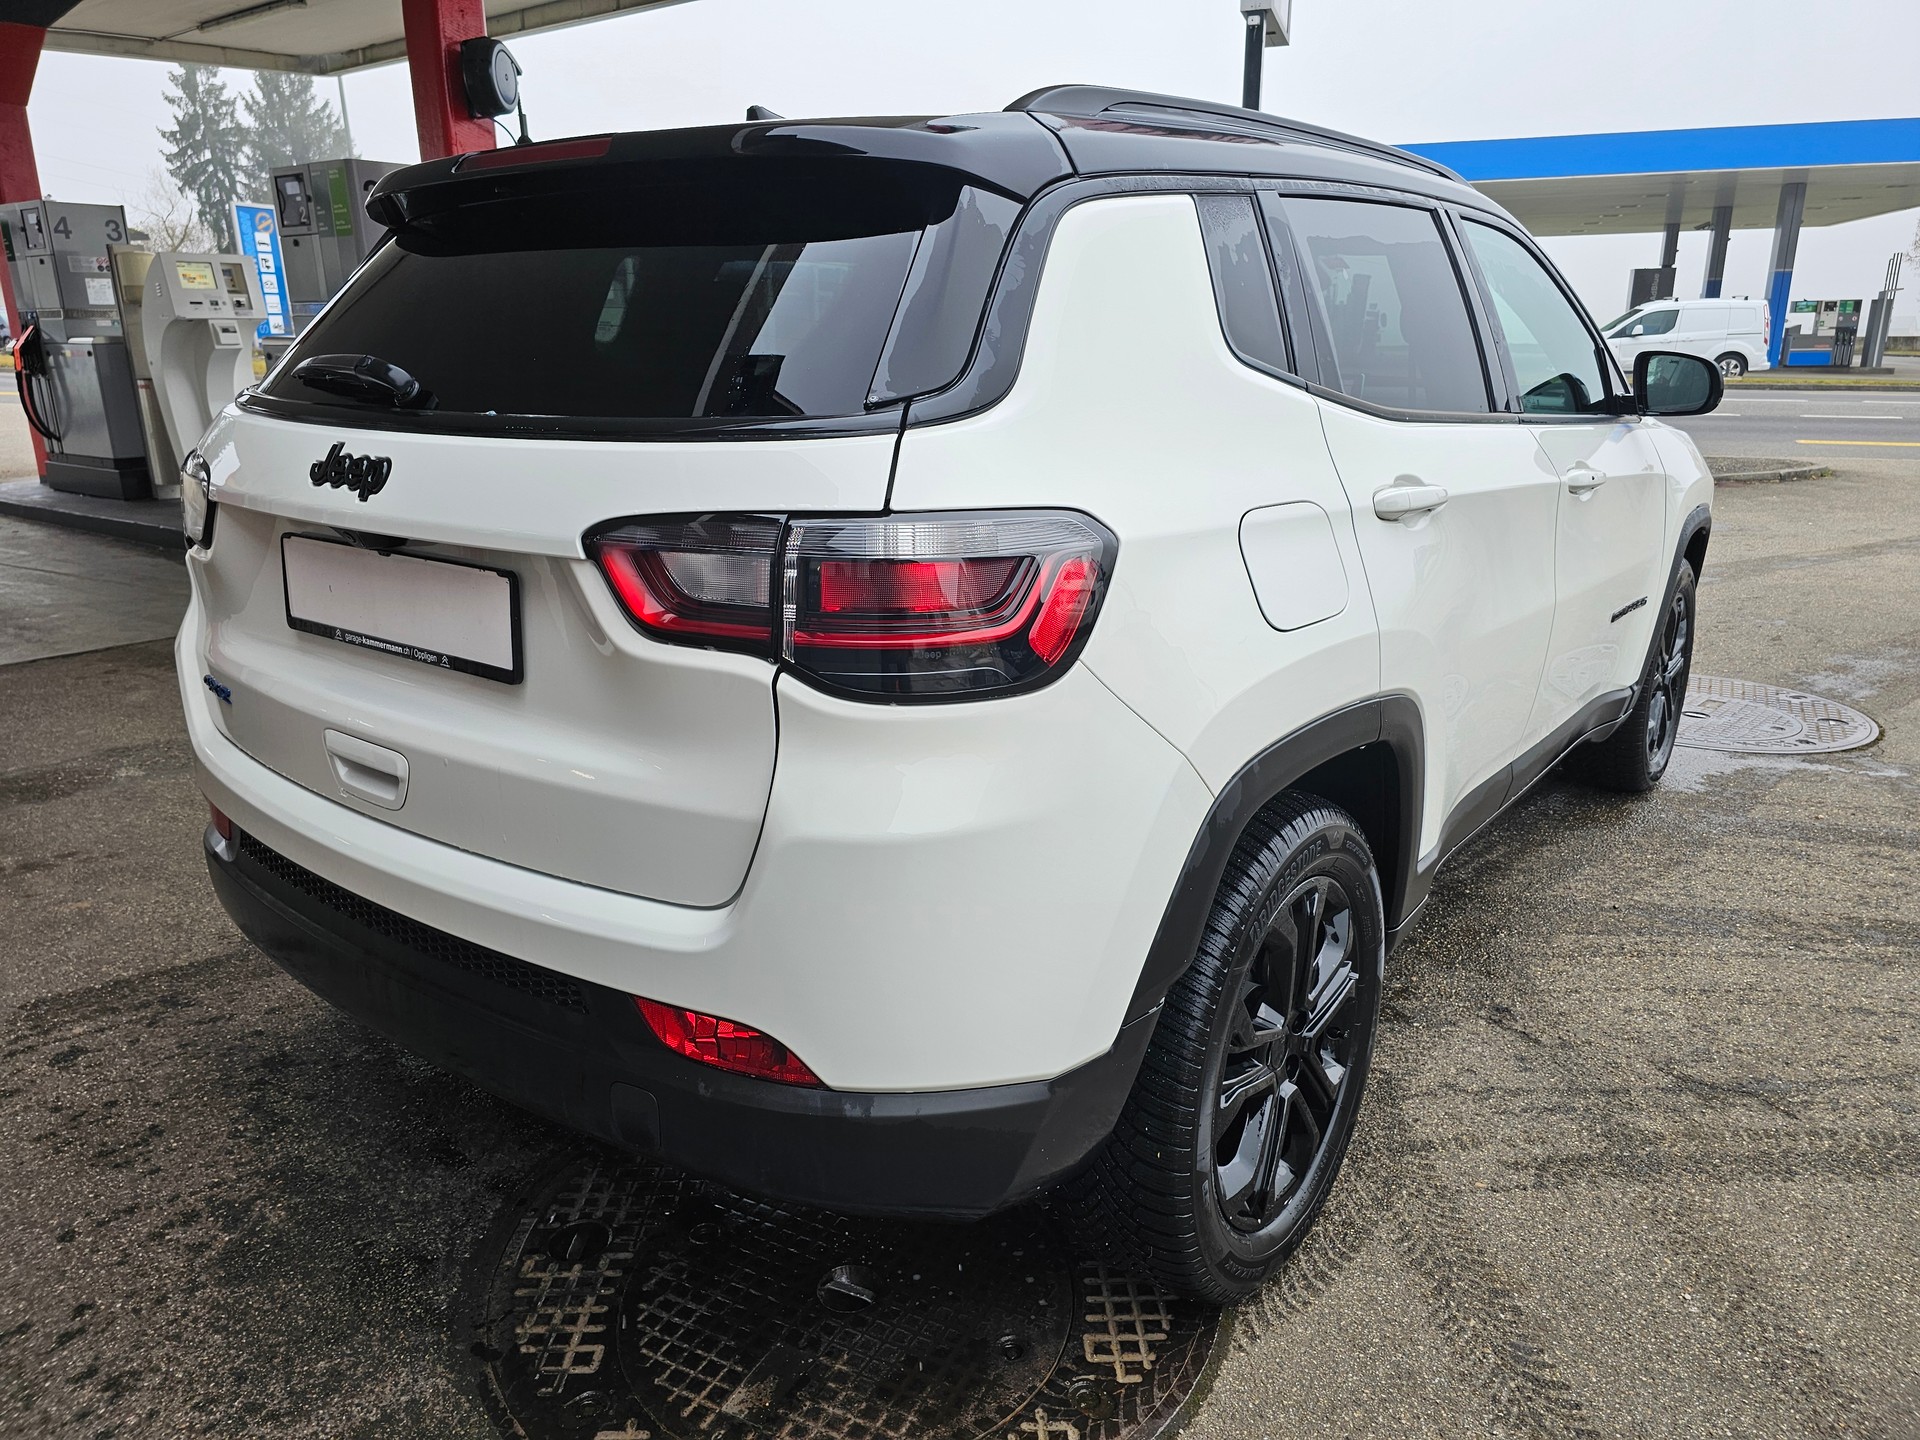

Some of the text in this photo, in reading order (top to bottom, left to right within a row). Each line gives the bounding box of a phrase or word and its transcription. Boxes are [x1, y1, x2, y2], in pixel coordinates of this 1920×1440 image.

[299, 206, 308, 223] 2
[53, 216, 73, 240] 4
[104, 219, 123, 243] 3
[309, 441, 392, 502] Jeep
[344, 633, 410, 655] garage-kammermann.ch
[414, 648, 438, 663] Oppligen
